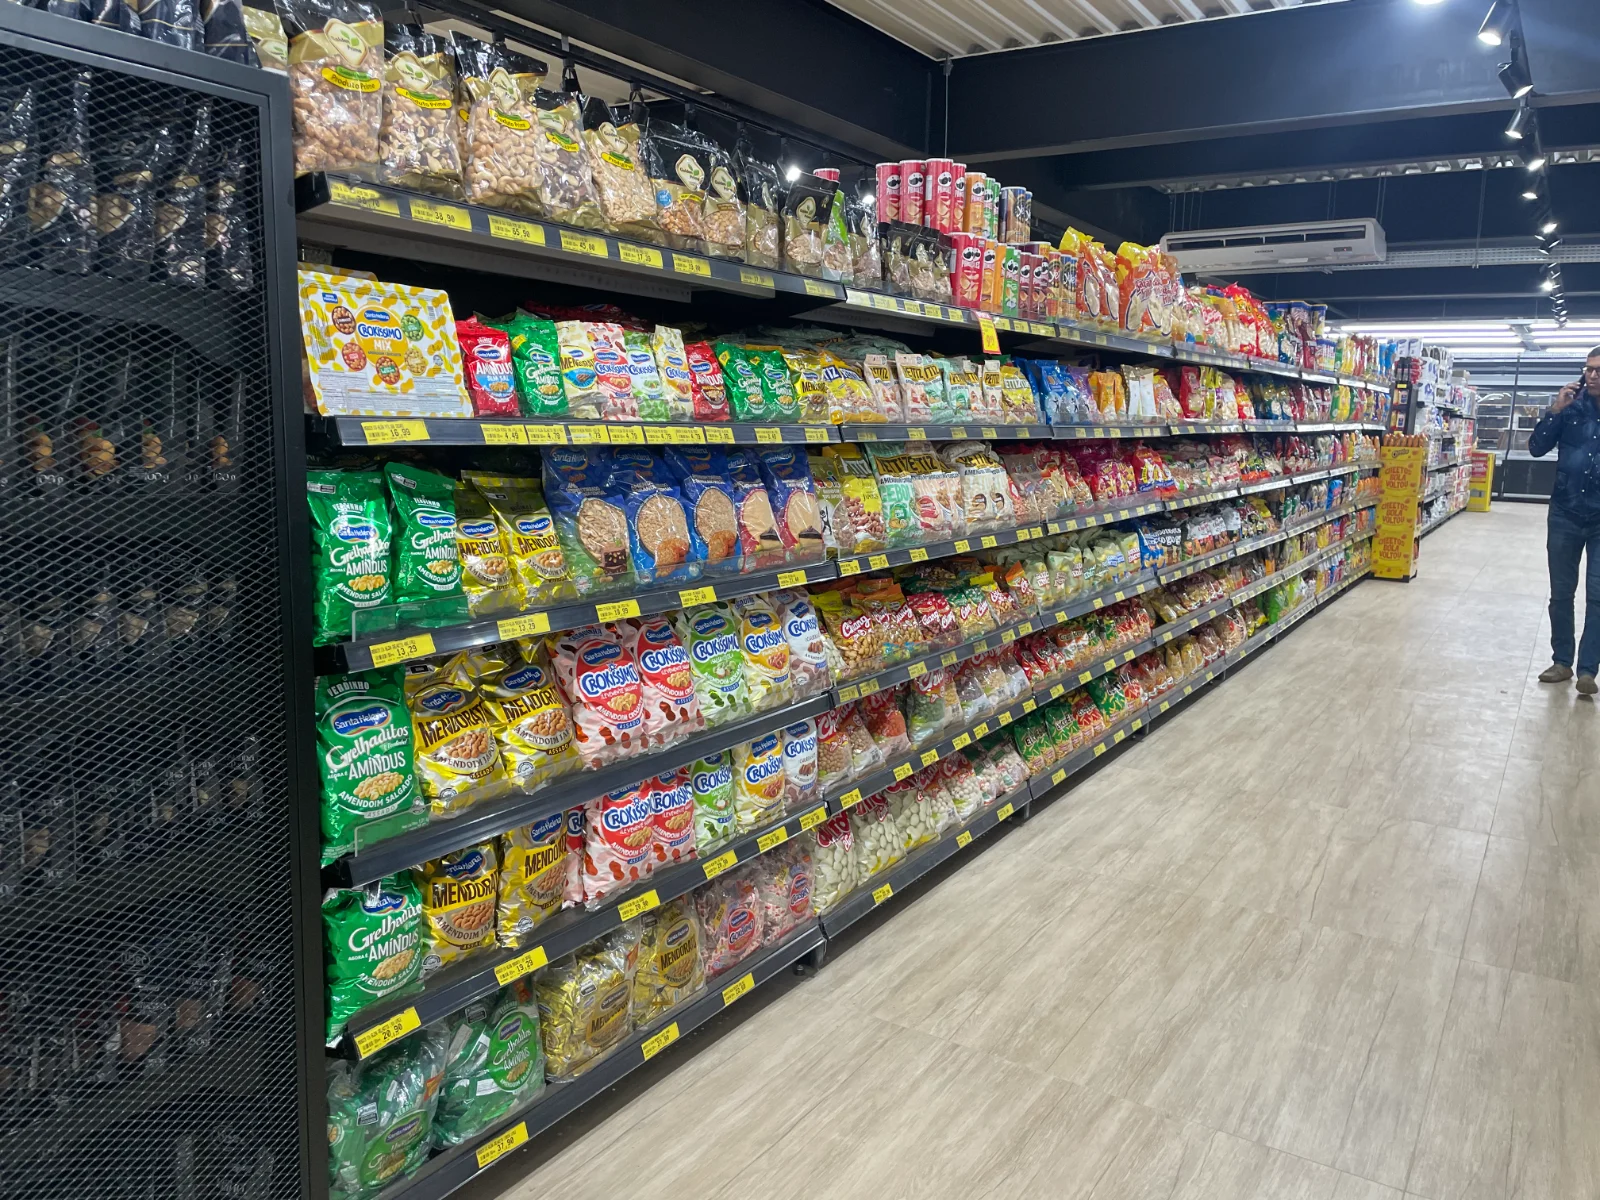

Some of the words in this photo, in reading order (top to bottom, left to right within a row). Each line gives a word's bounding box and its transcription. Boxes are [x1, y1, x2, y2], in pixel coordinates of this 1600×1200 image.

[358, 323, 402, 340] CROKISSIMO
[374, 340, 393, 351] MIX
[390, 428, 411, 438] 16,99
[1384, 466, 1412, 475] CHEETOS
[1385, 480, 1409, 489] VOLTOU
[1381, 502, 1409, 510] CHEETOS
[1382, 516, 1405, 525] VOLTOU
[1378, 537, 1405, 546] CHEETOS
[1379, 551, 1402, 560] VOLTOU
[346, 558, 387, 576] AMINDUS
[337, 583, 370, 600] AMENDOIM
[518, 622, 536, 632] 13,29
[396, 644, 418, 657] 13,29
[580, 663, 639, 696] CROKISSIMO
[327, 680, 371, 698] VERDINHO
[514, 726, 559, 744] AMENDOIM
[325, 724, 409, 770] Grelhaditos
[548, 744, 570, 756] ASSADO
[348, 752, 406, 780] AMINDUS
[471, 766, 494, 779] ASSADO
[338, 790, 384, 808] AMENDOIM
[385, 773, 413, 804] SALGADO
[435, 917, 480, 941] AMENDOIM
[368, 928, 419, 962] AMINDUS
[516, 959, 534, 972] 19,29
[382, 1023, 403, 1040] 20,90
[497, 1136, 515, 1152] 37,90
